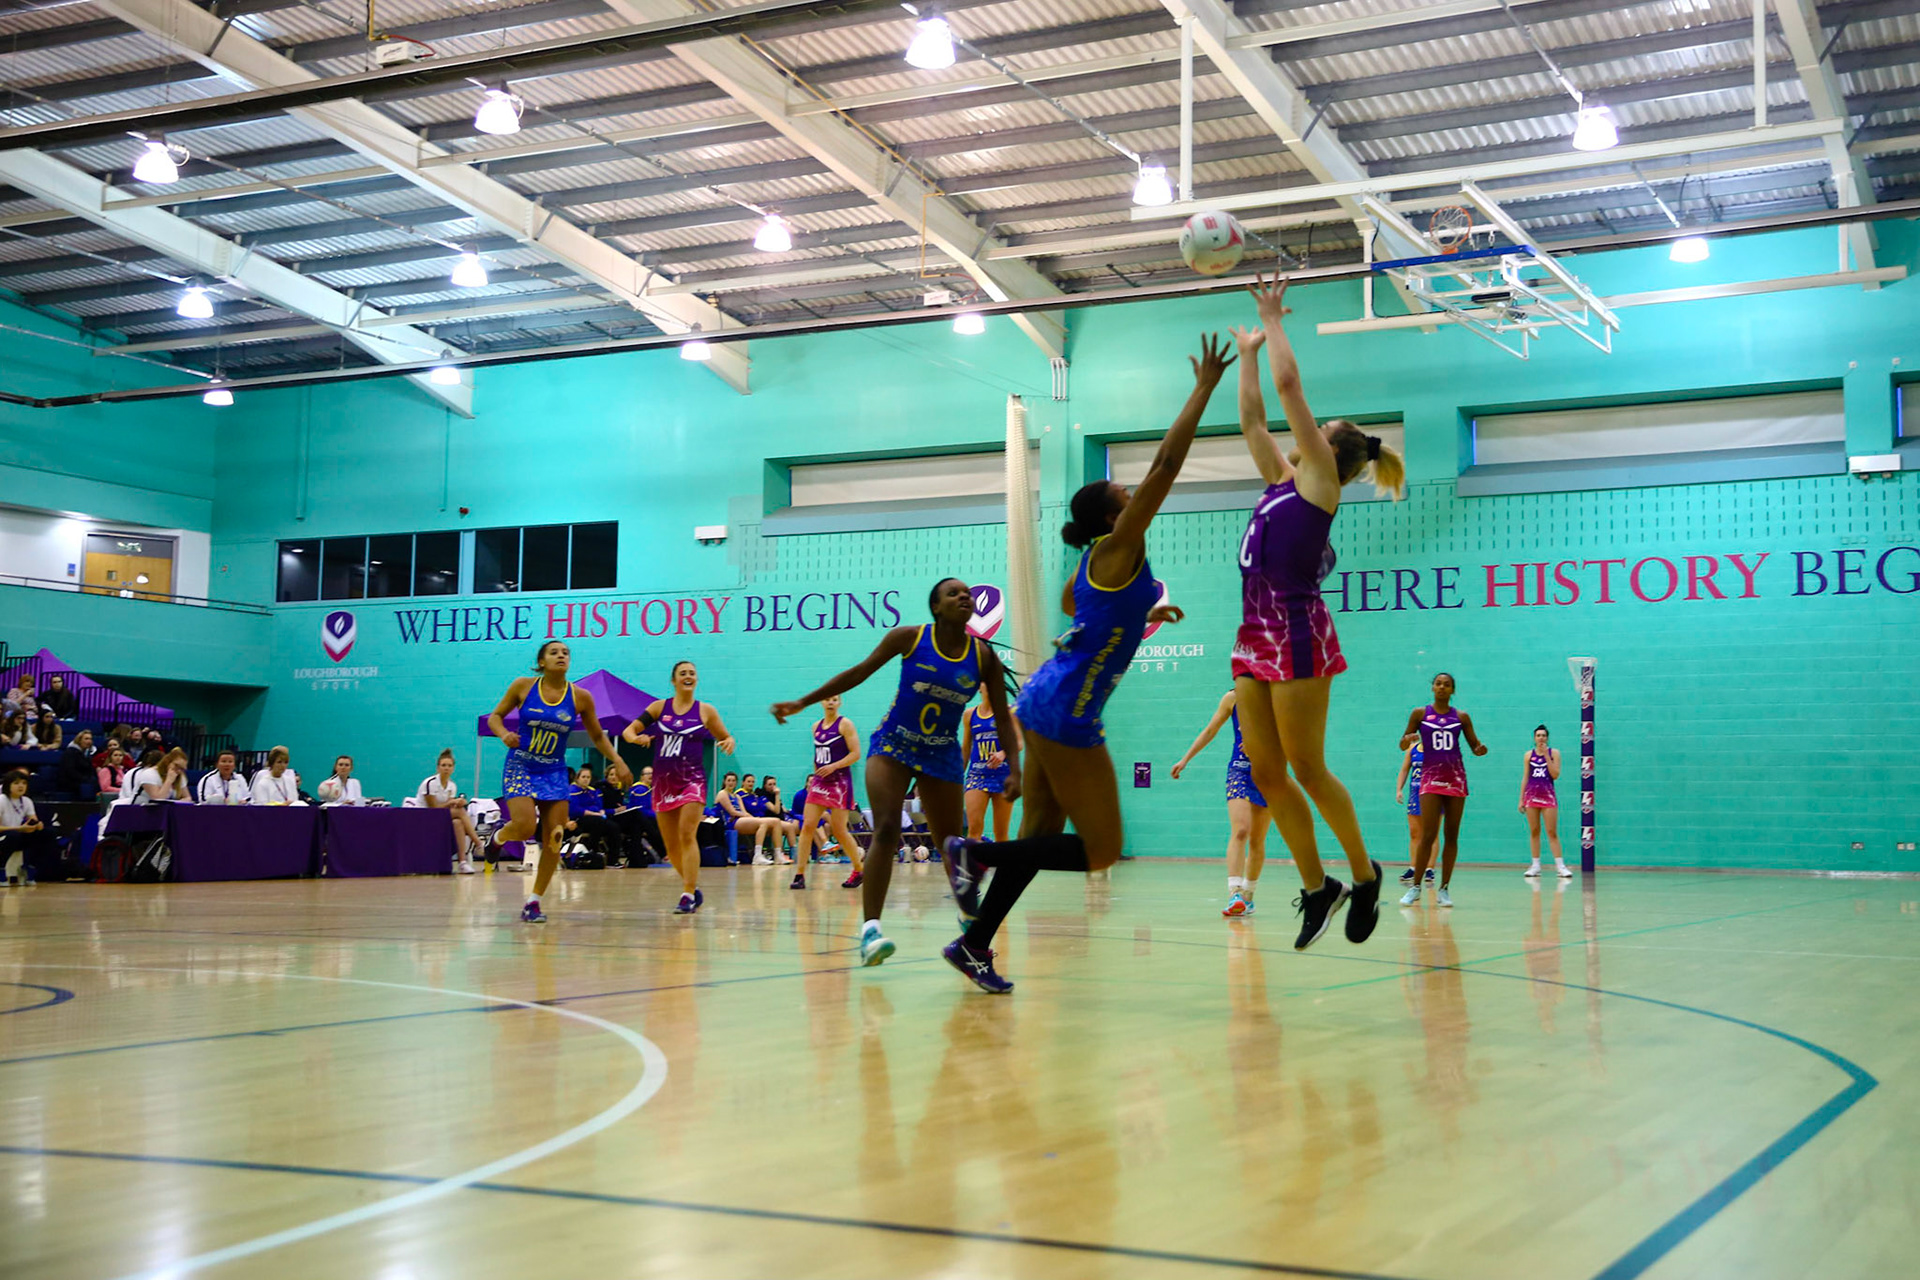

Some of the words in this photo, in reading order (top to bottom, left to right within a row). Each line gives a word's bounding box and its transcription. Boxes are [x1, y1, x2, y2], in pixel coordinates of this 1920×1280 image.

[1320, 567, 1464, 612] HERE
[1481, 552, 1771, 608] HISTORY
[1789, 546, 1920, 597] BEG
[394, 605, 533, 643] WHERE
[544, 597, 731, 638] HISTORY
[743, 590, 900, 632] BEGINS
[1133, 644, 1204, 659] BOROUGH
[294, 666, 379, 679] LOUGHBOROUGH
[1127, 662, 1179, 673] PORT
[311, 681, 361, 691] SPORT
[919, 702, 941, 735] C
[528, 726, 559, 755] WD
[660, 734, 683, 757] WA
[1432, 731, 1454, 750] GD
[815, 746, 832, 765] WD
